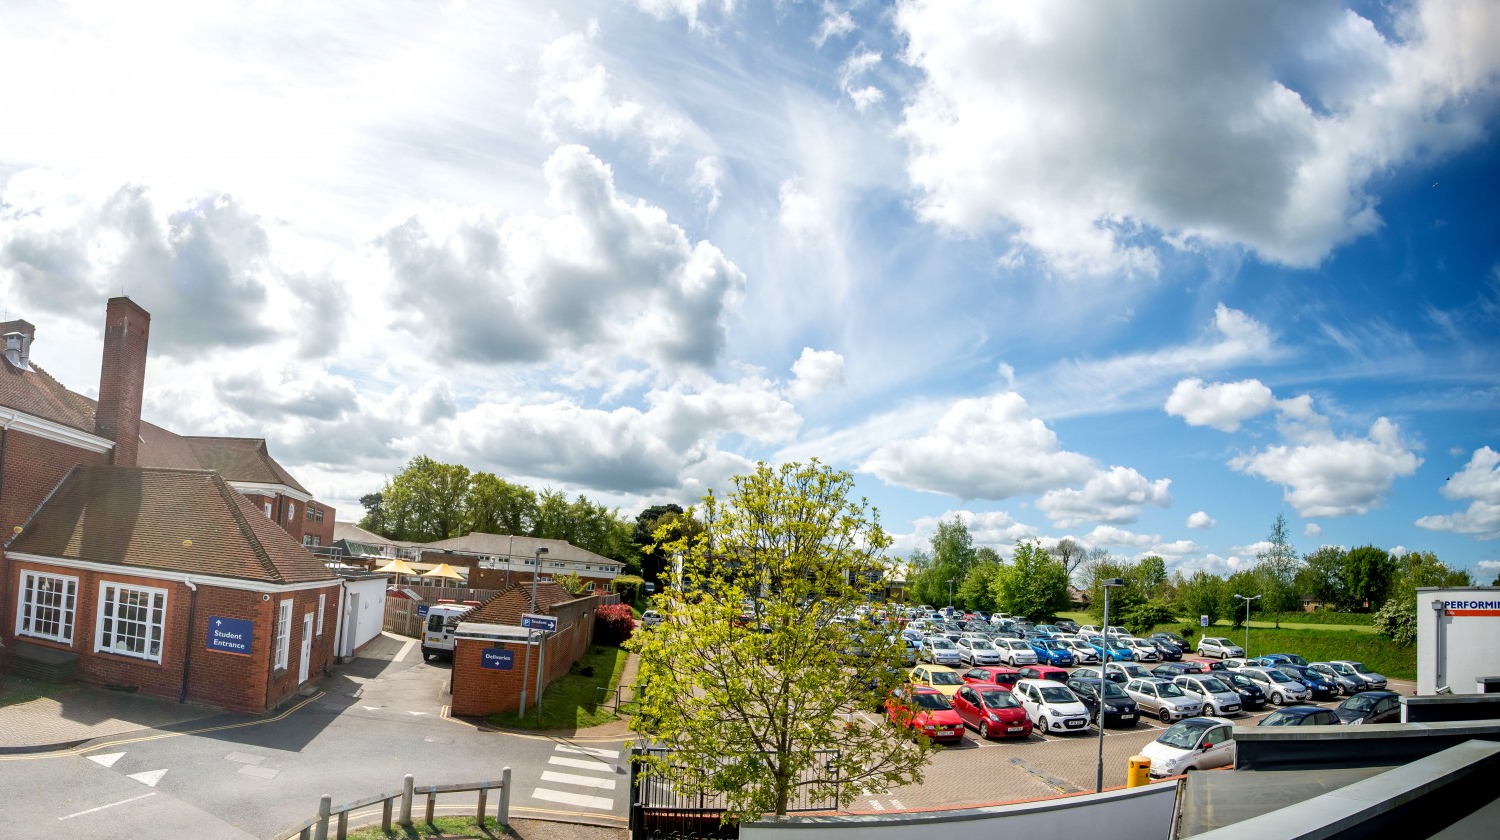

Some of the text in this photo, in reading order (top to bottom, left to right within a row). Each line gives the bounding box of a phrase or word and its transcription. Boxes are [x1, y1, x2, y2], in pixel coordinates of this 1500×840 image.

[214, 629, 242, 640] Student
[213, 638, 245, 649] Entrance
[485, 653, 511, 661] Deliveries
